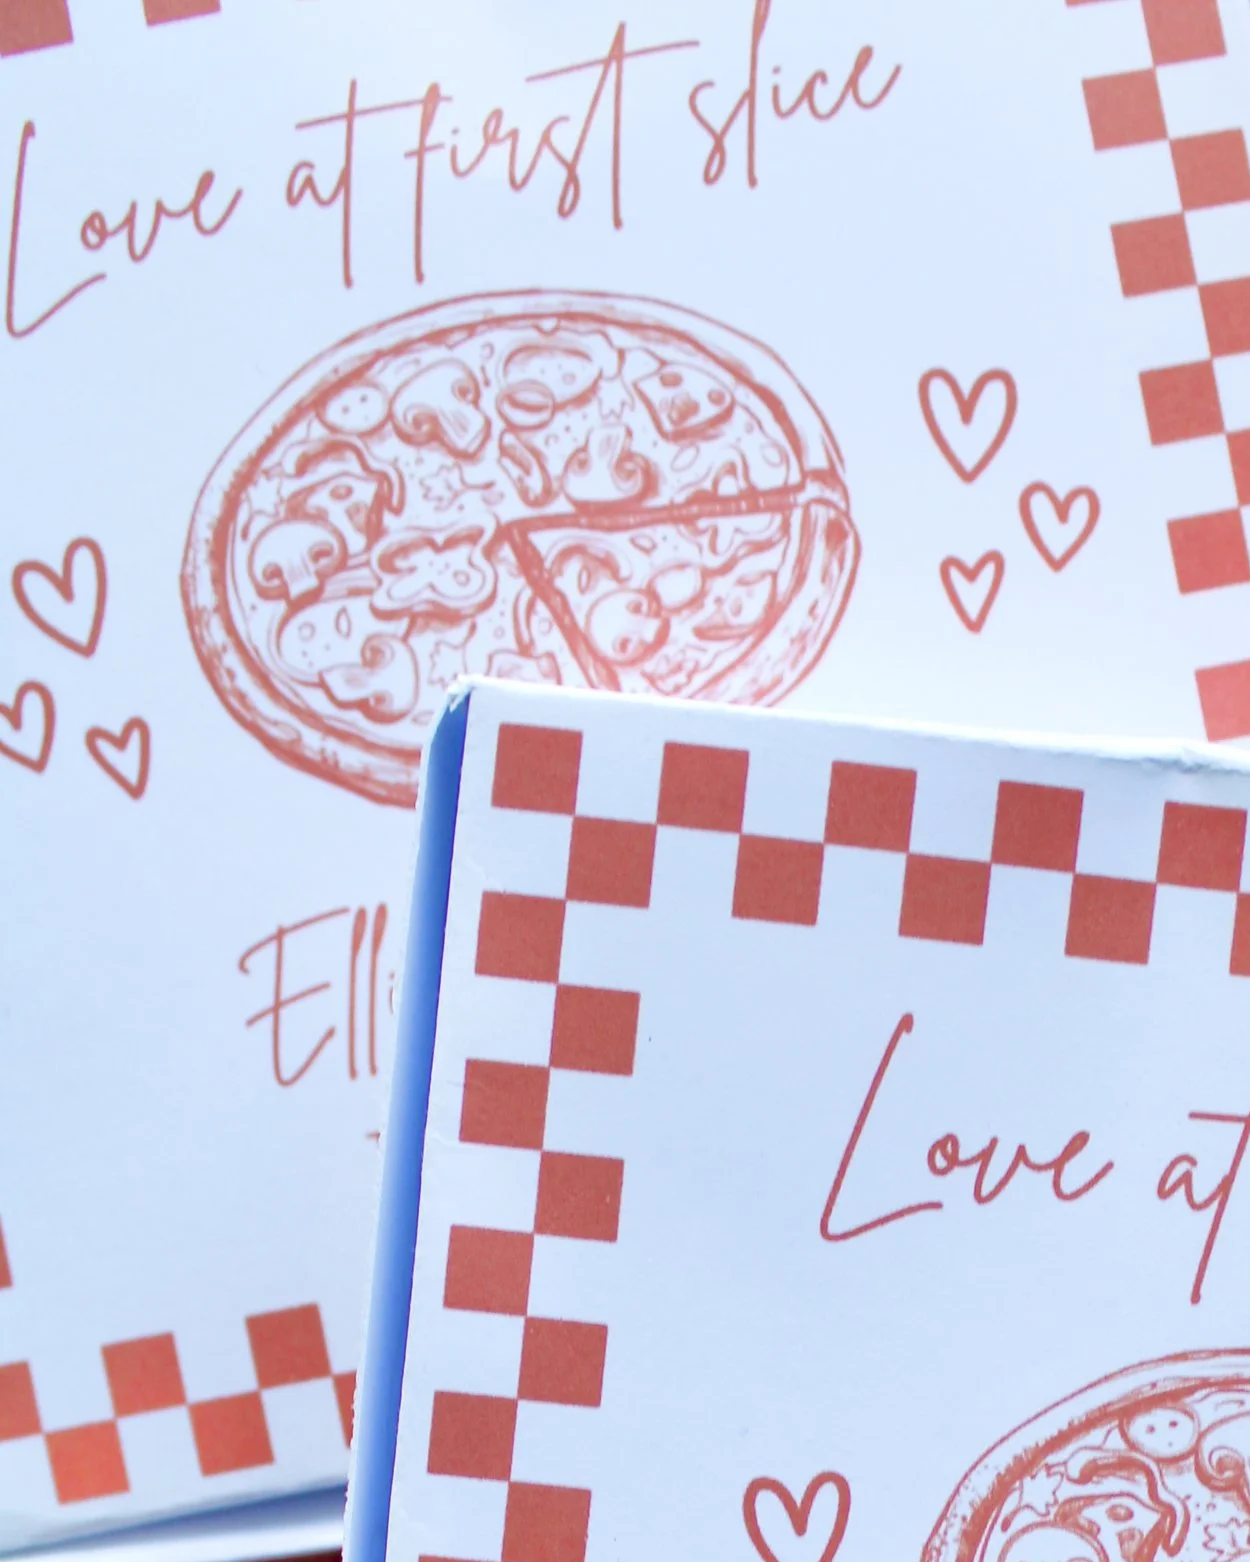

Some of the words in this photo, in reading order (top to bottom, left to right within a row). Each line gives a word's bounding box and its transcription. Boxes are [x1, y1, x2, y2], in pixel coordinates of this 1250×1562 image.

[5, 119, 243, 339] Love
[285, 79, 452, 288] at
[404, 22, 700, 284] first
[688, 0, 903, 190] slice
[819, 1012, 1115, 1243] Love
